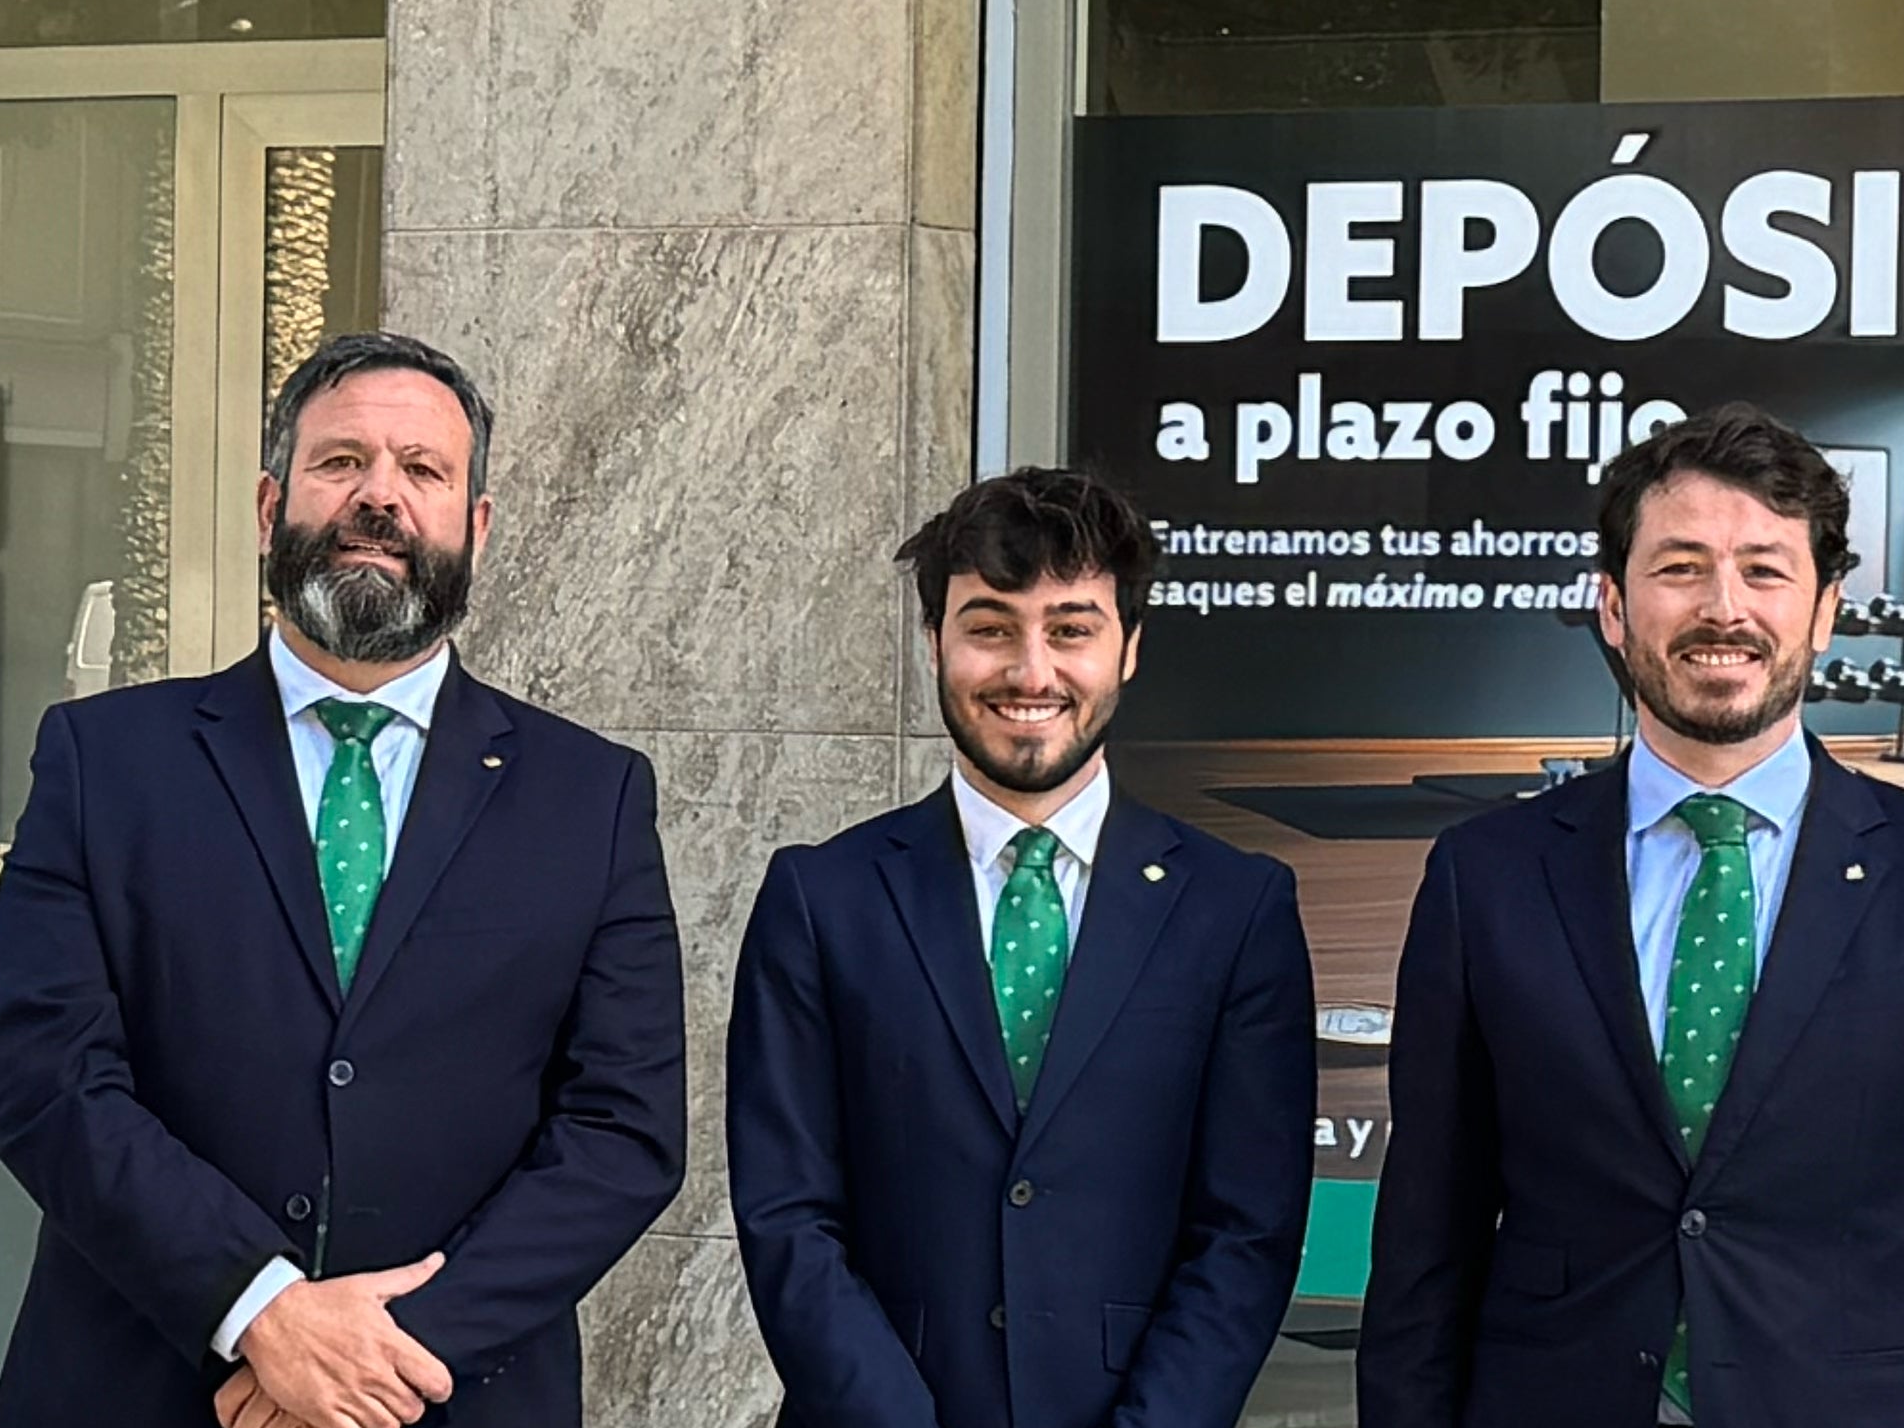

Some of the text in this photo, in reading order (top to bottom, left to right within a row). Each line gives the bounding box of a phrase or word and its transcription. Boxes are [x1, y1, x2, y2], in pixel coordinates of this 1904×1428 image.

[1155, 400, 1211, 461] a
[1235, 371, 1496, 484] plazo
[1380, 524, 1441, 557] tus
[1450, 518, 1600, 557] ahorros
[1147, 579, 1276, 616] saques
[1284, 571, 1318, 609] el
[1326, 573, 1485, 609] máximo
